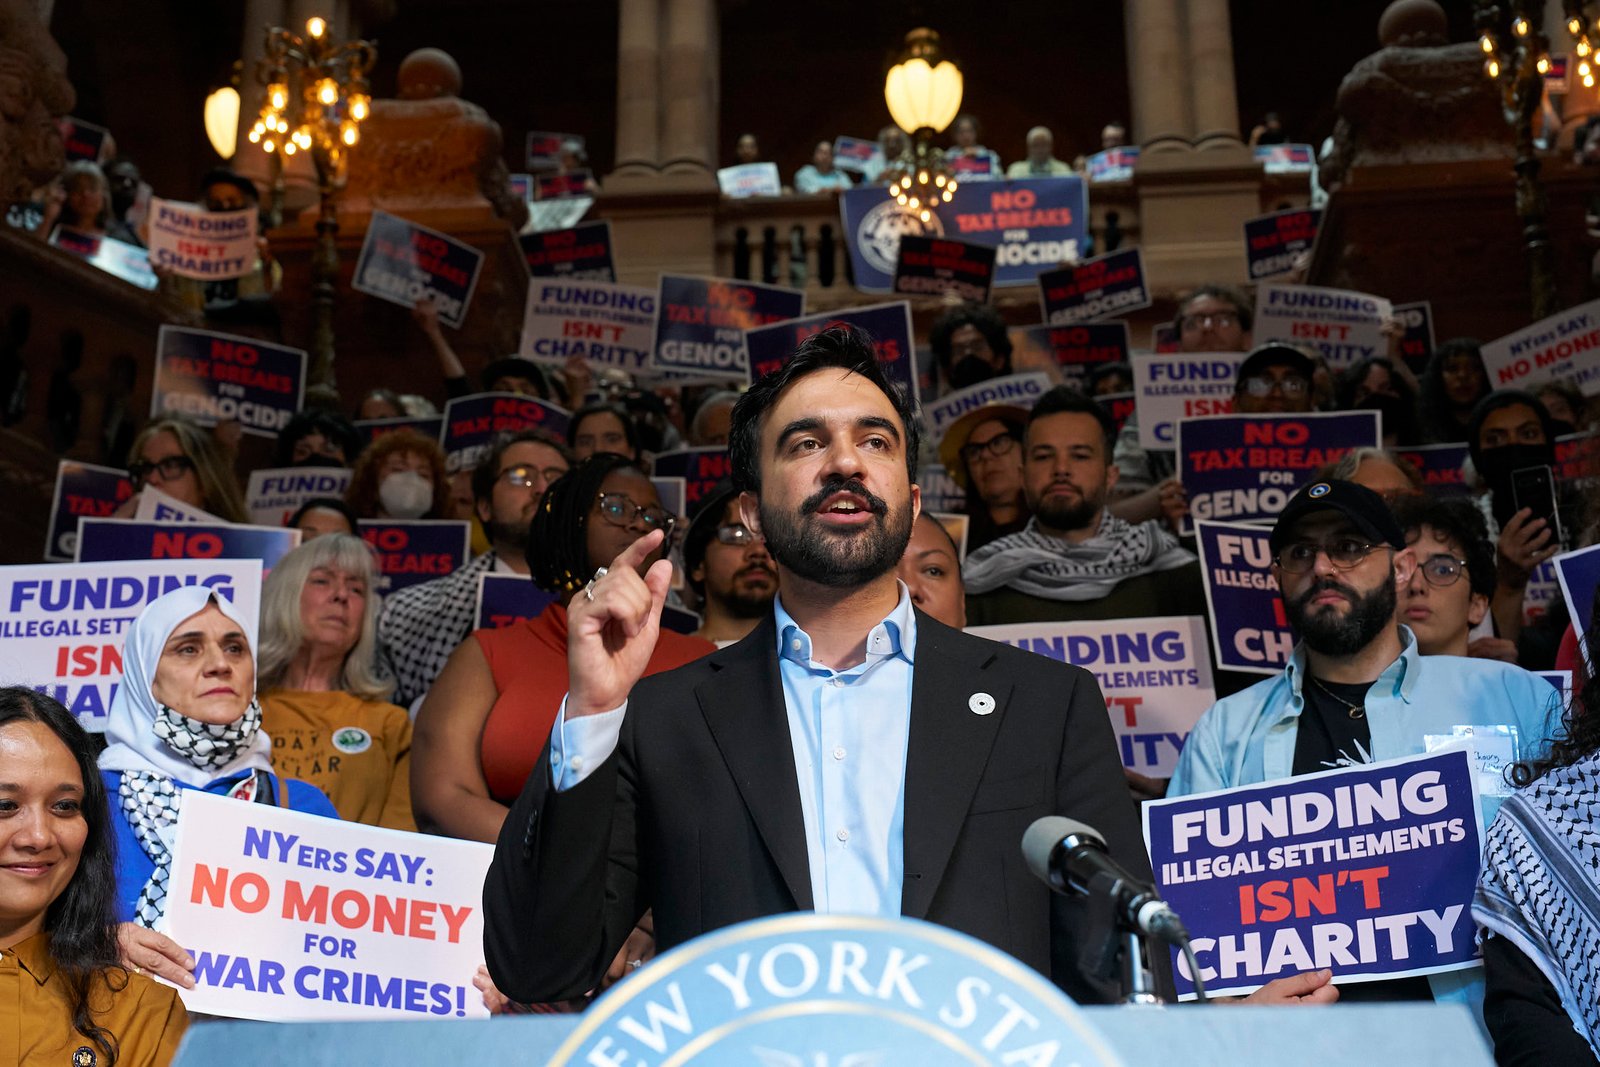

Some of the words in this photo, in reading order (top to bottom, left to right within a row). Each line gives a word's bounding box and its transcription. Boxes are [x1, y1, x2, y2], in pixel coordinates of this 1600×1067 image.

[991, 189, 1037, 209] NO
[159, 207, 248, 231] FUNDING
[955, 213, 994, 233] TAX
[542, 286, 655, 314] FUNDING
[1270, 291, 1378, 313] FUNDING
[563, 319, 625, 343] ISN'T
[1292, 322, 1351, 340] ISN'T
[210, 338, 259, 367] NO
[534, 339, 649, 367] CHARITY
[660, 340, 747, 370] GENOC
[1320, 343, 1375, 361] RITY
[1499, 359, 1530, 384] NO
[1535, 329, 1600, 368] MONE
[211, 362, 293, 394] BREAKS
[493, 398, 545, 422] NO
[933, 379, 1041, 425] FUNDING
[1185, 399, 1233, 417] ISN
[1243, 422, 1310, 446] NO
[1189, 449, 1244, 472] TAX
[261, 474, 345, 495] FUNDI
[1258, 470, 1295, 485] FOR
[1190, 487, 1300, 520] GENO
[151, 531, 224, 559] NO
[1214, 568, 1280, 592] ILLEGA
[56, 644, 124, 678] ISN
[1172, 770, 1448, 854] FUNDING
[1161, 846, 1265, 885] ILLEGAL
[1268, 818, 1466, 870] SETTLEMENTS
[354, 847, 433, 886] SAY:
[190, 862, 270, 914] NO
[282, 879, 473, 944] MONEY
[1239, 867, 1390, 925] ISN'T
[304, 933, 357, 959] FOR
[1176, 904, 1465, 982] CHARITY
[187, 949, 286, 996] WAR
[294, 965, 466, 1017] CRIMES!
[706, 941, 931, 1010] YORK
